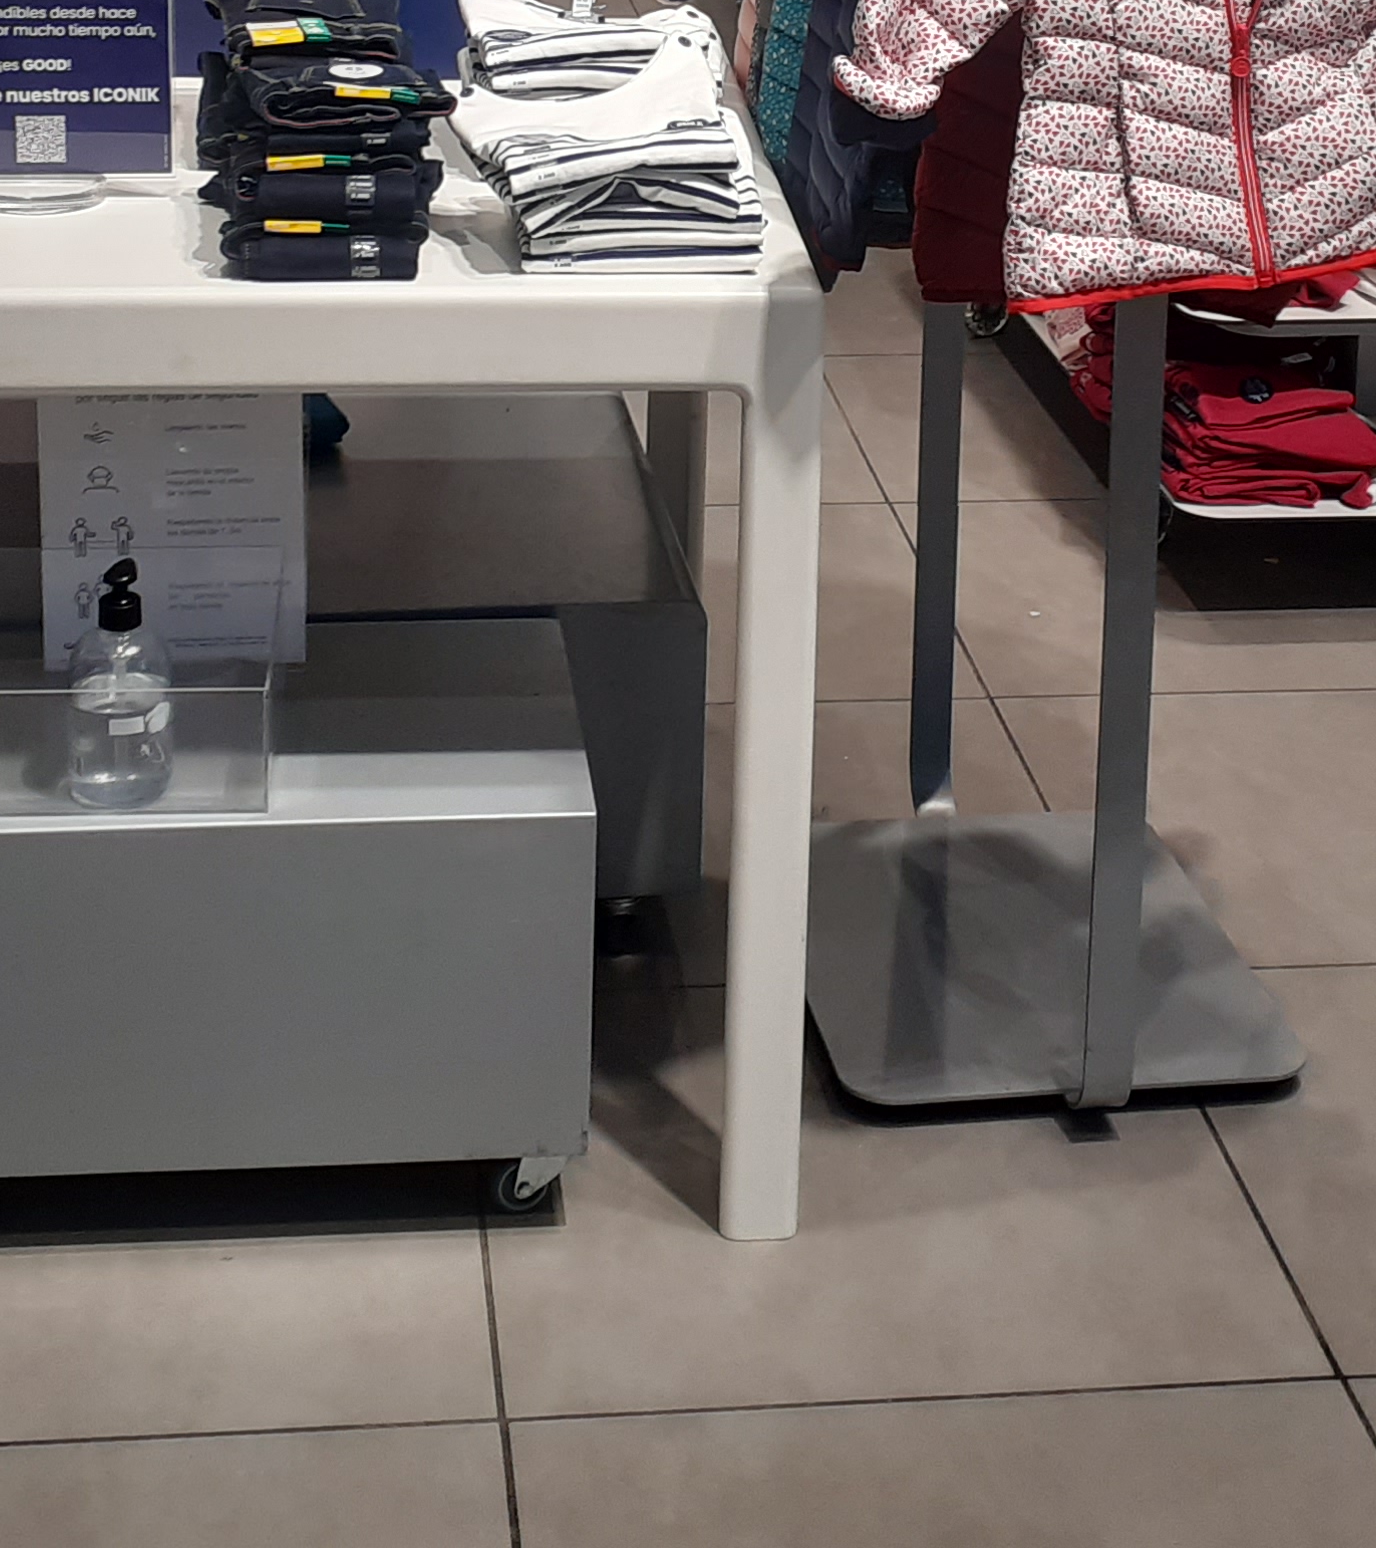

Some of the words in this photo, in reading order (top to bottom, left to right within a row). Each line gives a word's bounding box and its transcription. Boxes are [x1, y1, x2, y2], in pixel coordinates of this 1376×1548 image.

[49, 6, 96, 19] desde
[98, 6, 137, 19] hace
[12, 23, 66, 37] mucho
[68, 23, 121, 40] tiempo
[123, 23, 157, 38] aún,
[21, 58, 73, 71] GOOD!
[5, 87, 91, 103] nuestros
[92, 87, 161, 103] ICONIK
